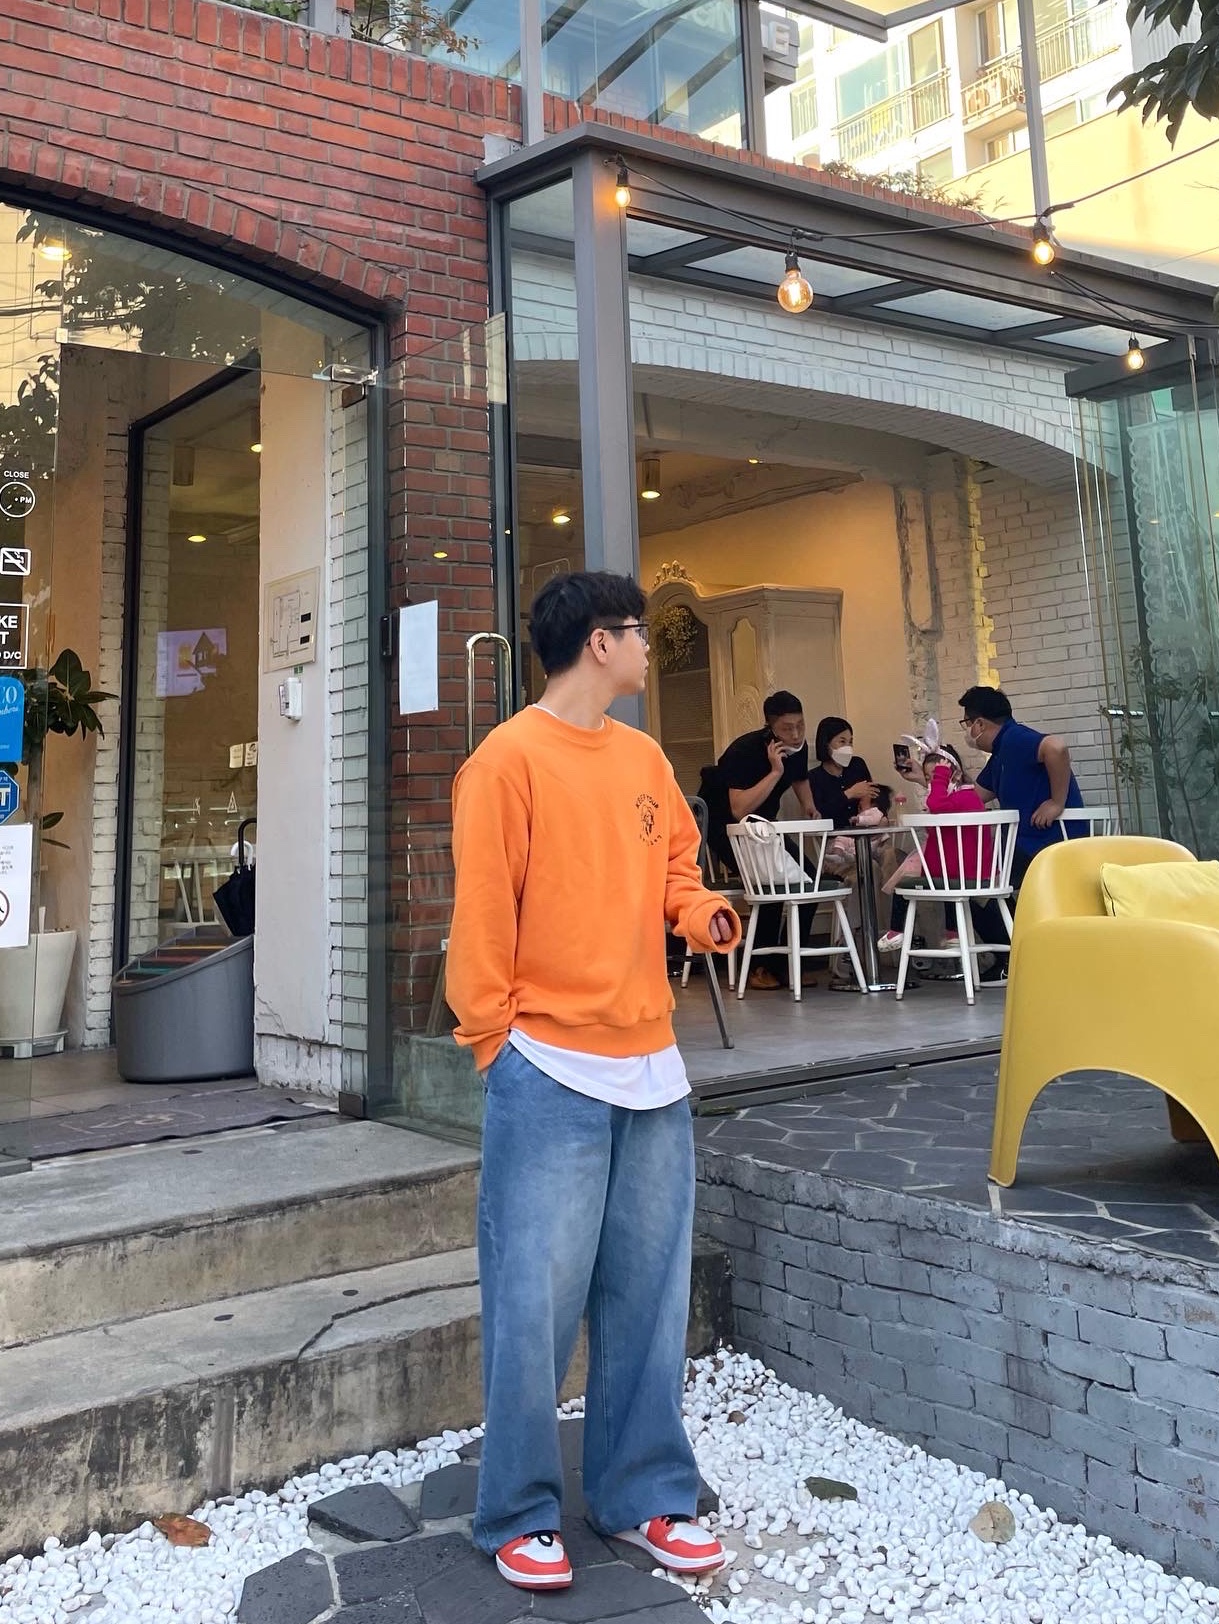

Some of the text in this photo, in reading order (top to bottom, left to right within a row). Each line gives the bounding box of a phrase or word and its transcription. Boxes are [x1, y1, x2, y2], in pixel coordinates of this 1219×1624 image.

[4, 470, 30, 479] CLOSE
[20, 496, 32, 504] PM
[3, 651, 22, 660] D/C
